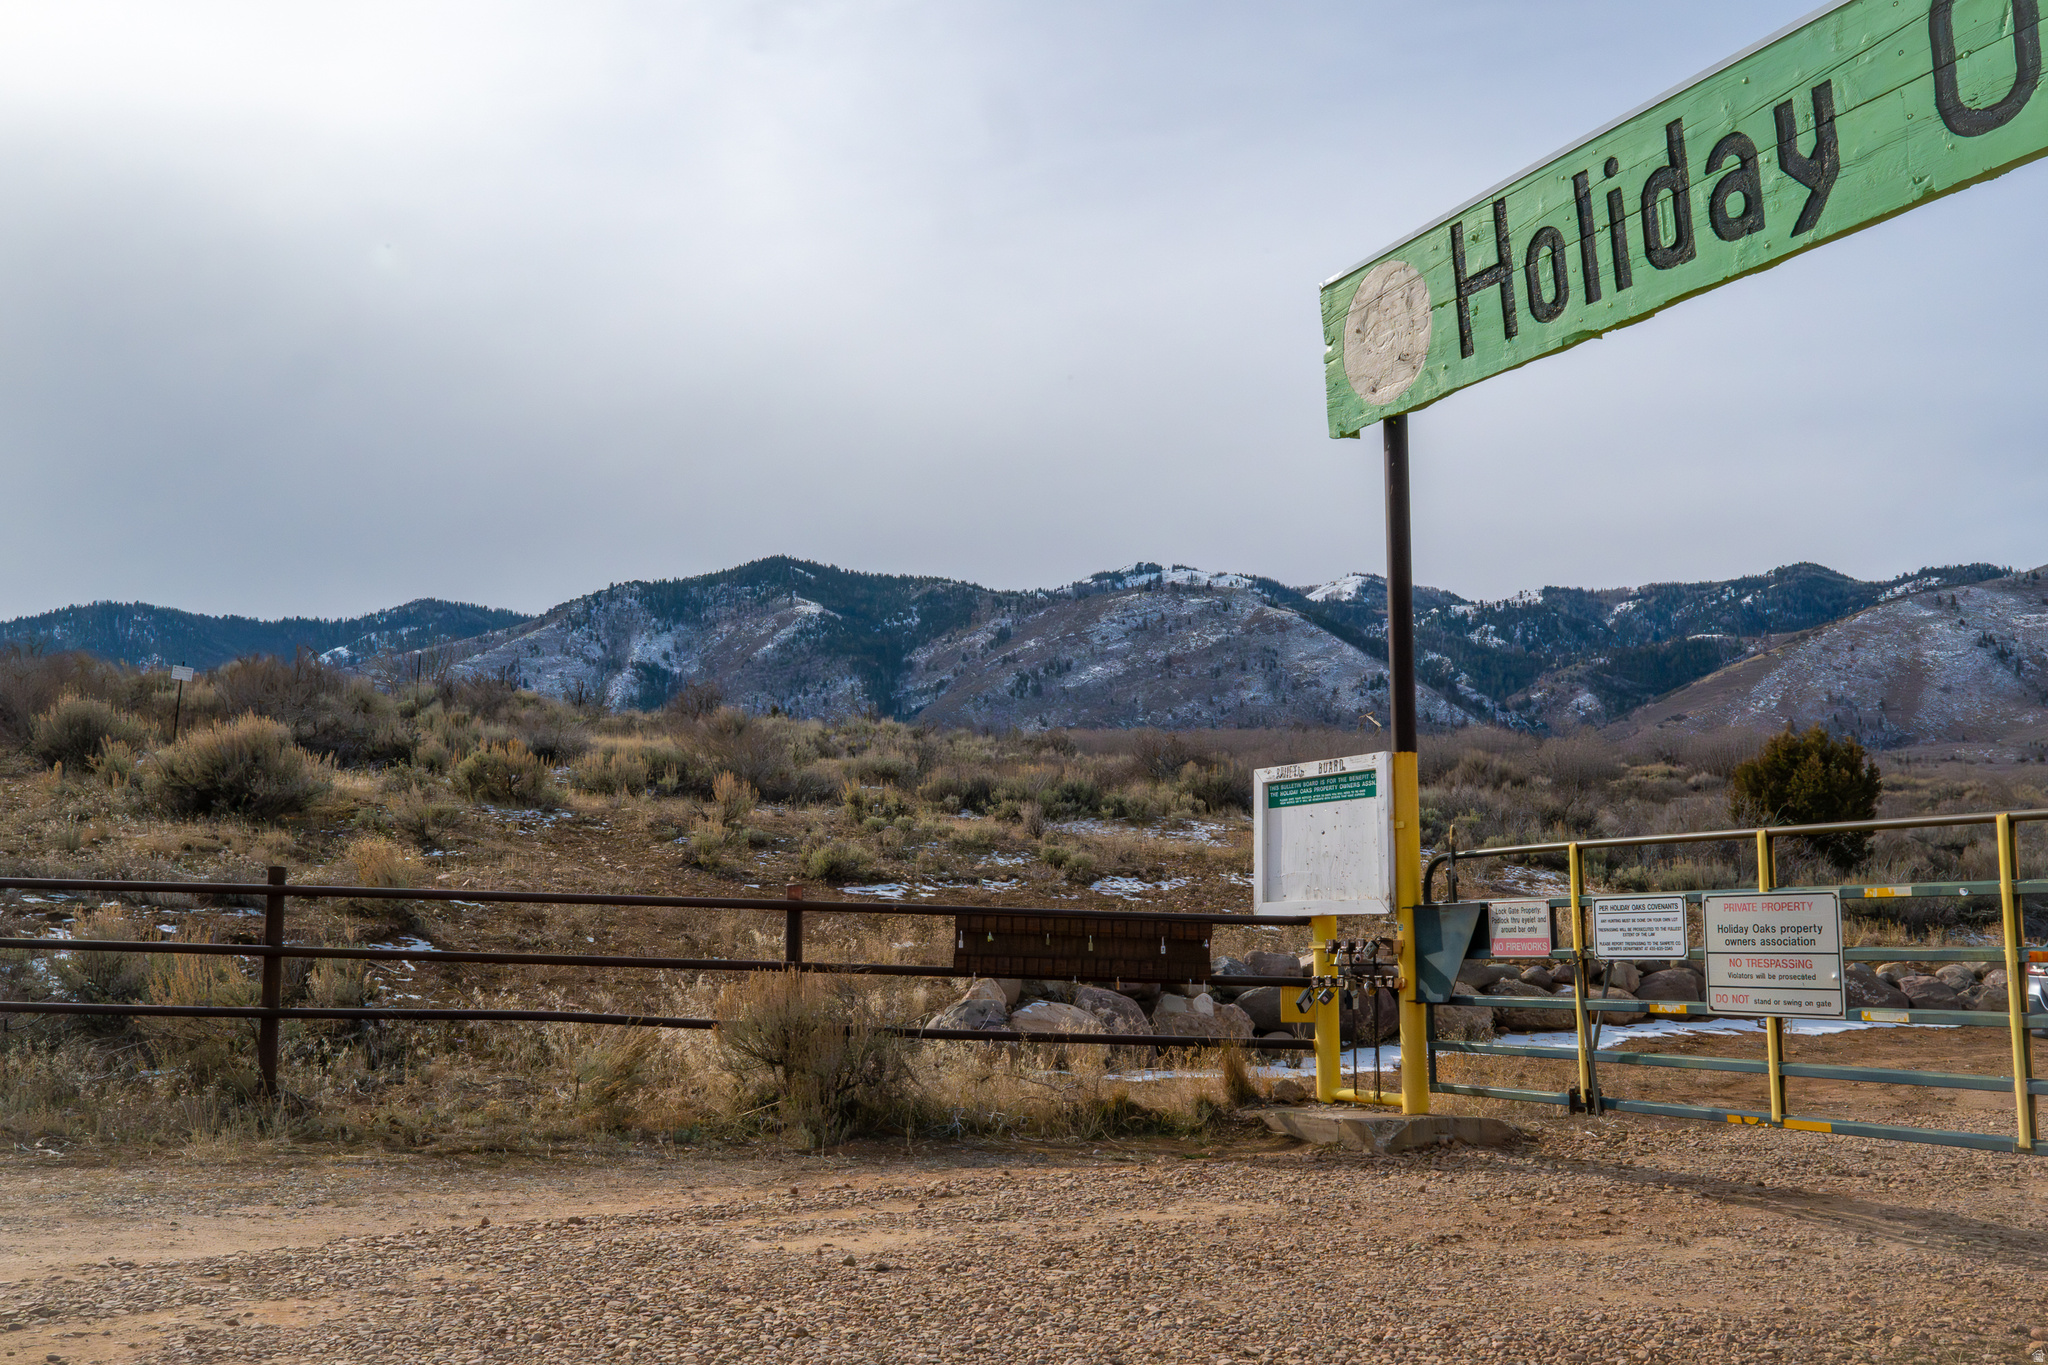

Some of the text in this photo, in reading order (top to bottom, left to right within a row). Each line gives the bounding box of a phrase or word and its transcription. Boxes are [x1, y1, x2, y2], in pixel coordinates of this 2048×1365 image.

[1451, 79, 1839, 359] Holiday
[1724, 902, 1813, 912] PRIVATE PROPERTY
[1717, 924, 1822, 935] Holiday Oaks property
[1760, 936, 1816, 946] association
[1494, 942, 1548, 951] NO FIREWORKS
[1729, 958, 1742, 968] NO
[1716, 994, 1728, 1003] DO
[1732, 994, 1749, 1004] NOT
